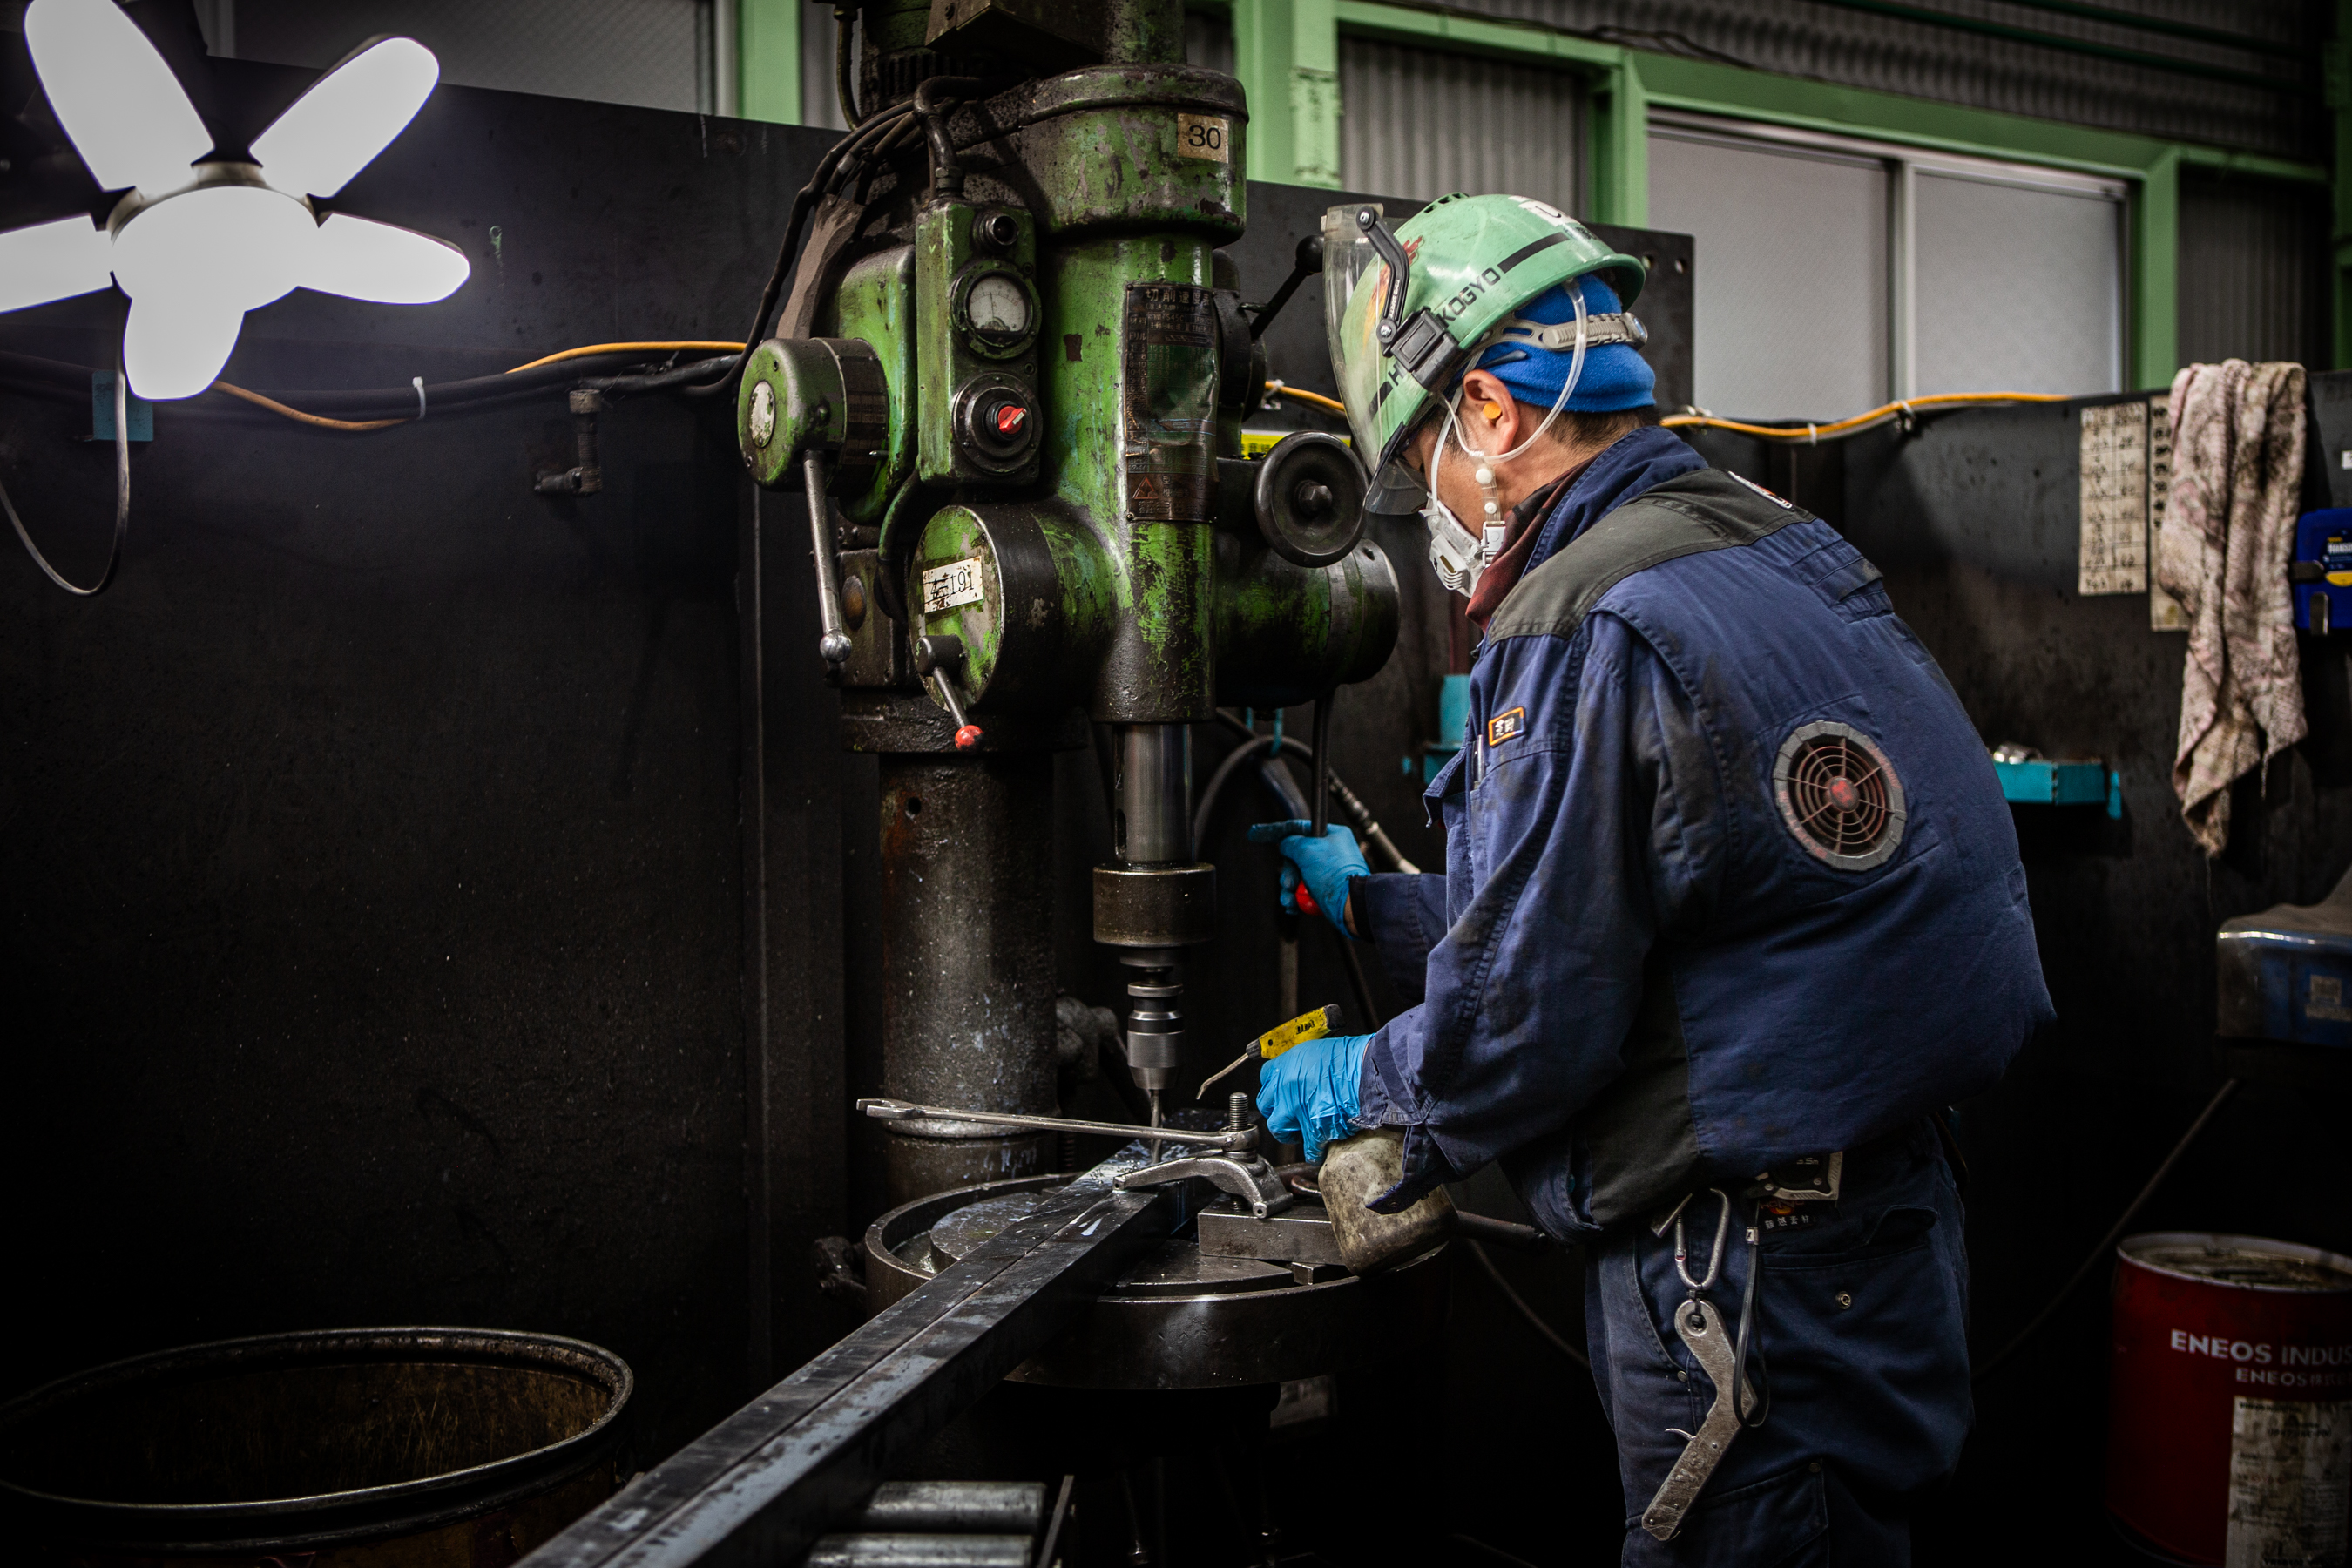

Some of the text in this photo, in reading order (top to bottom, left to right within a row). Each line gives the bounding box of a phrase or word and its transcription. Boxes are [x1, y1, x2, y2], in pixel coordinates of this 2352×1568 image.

[1188, 125, 1221, 150] 30
[1441, 267, 1501, 322] KOGYO
[2170, 1328, 2352, 1368] ENEOS INDUS
